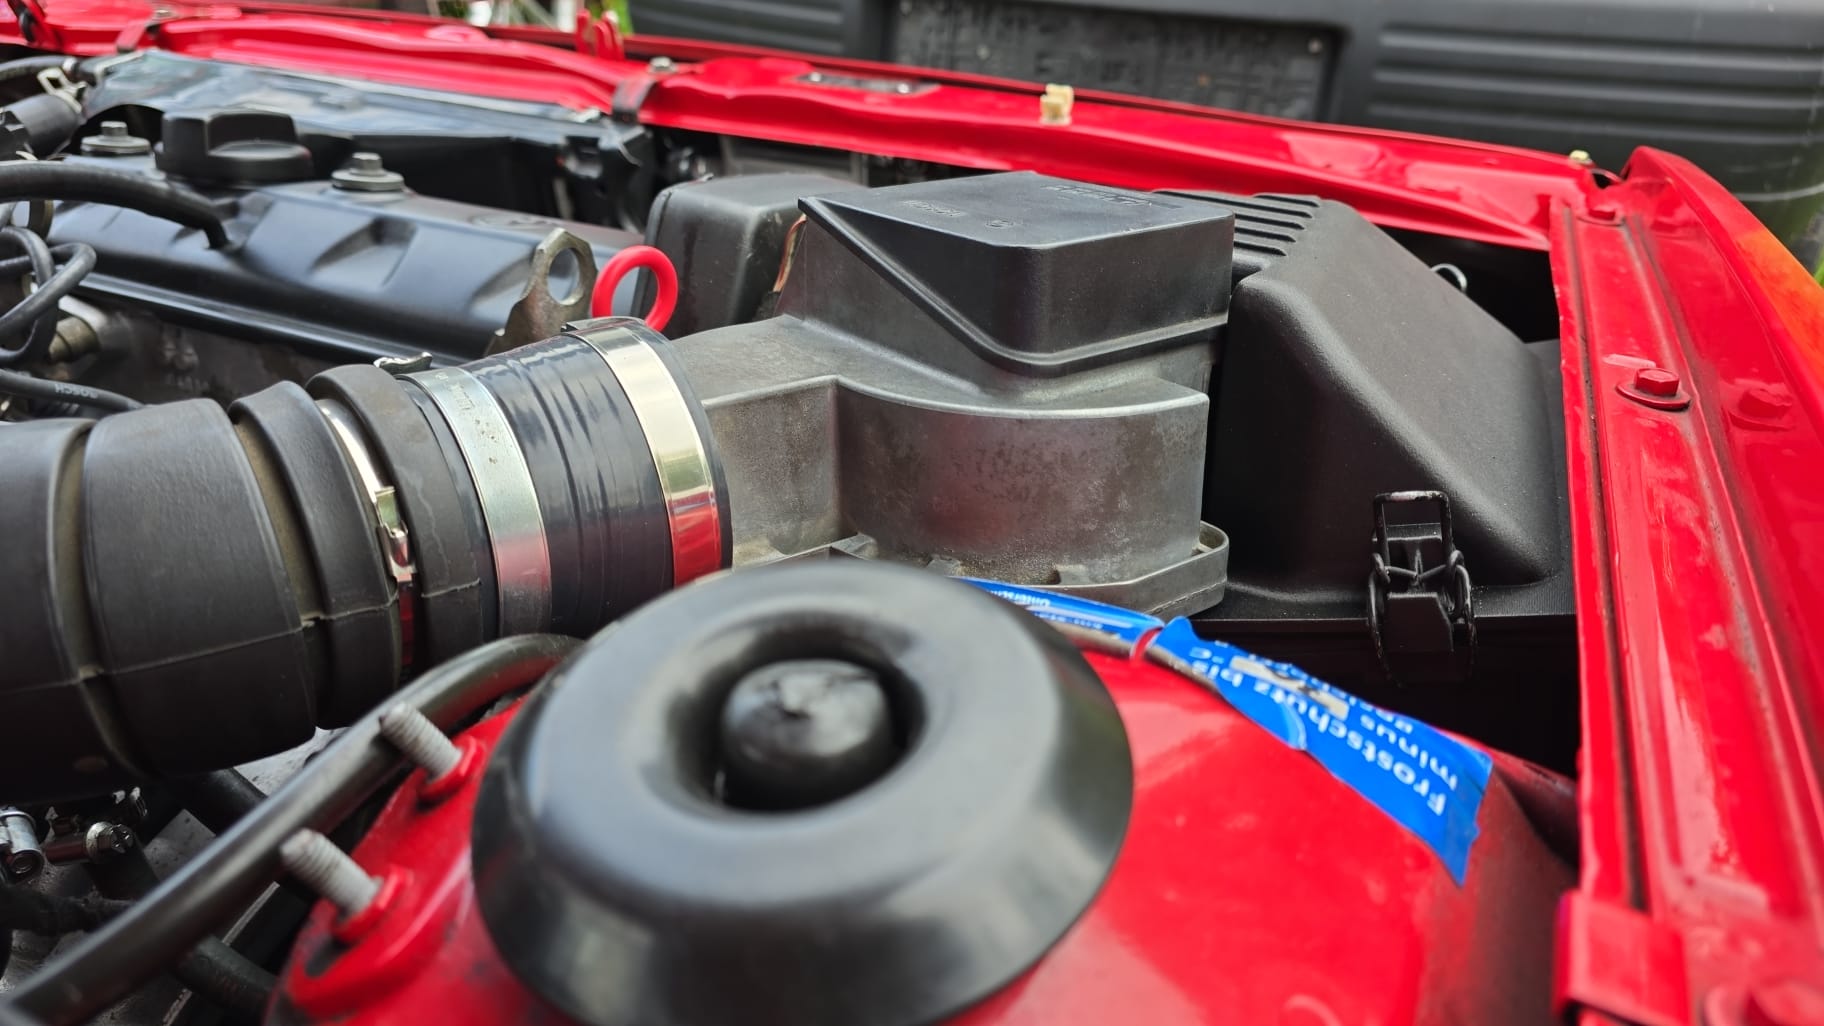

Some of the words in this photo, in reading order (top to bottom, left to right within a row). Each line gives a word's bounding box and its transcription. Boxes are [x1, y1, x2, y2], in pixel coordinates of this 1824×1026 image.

[1191, 660, 1243, 687] bis
[1253, 681, 1447, 816] Frostschutz
[1360, 714, 1458, 791] minus
